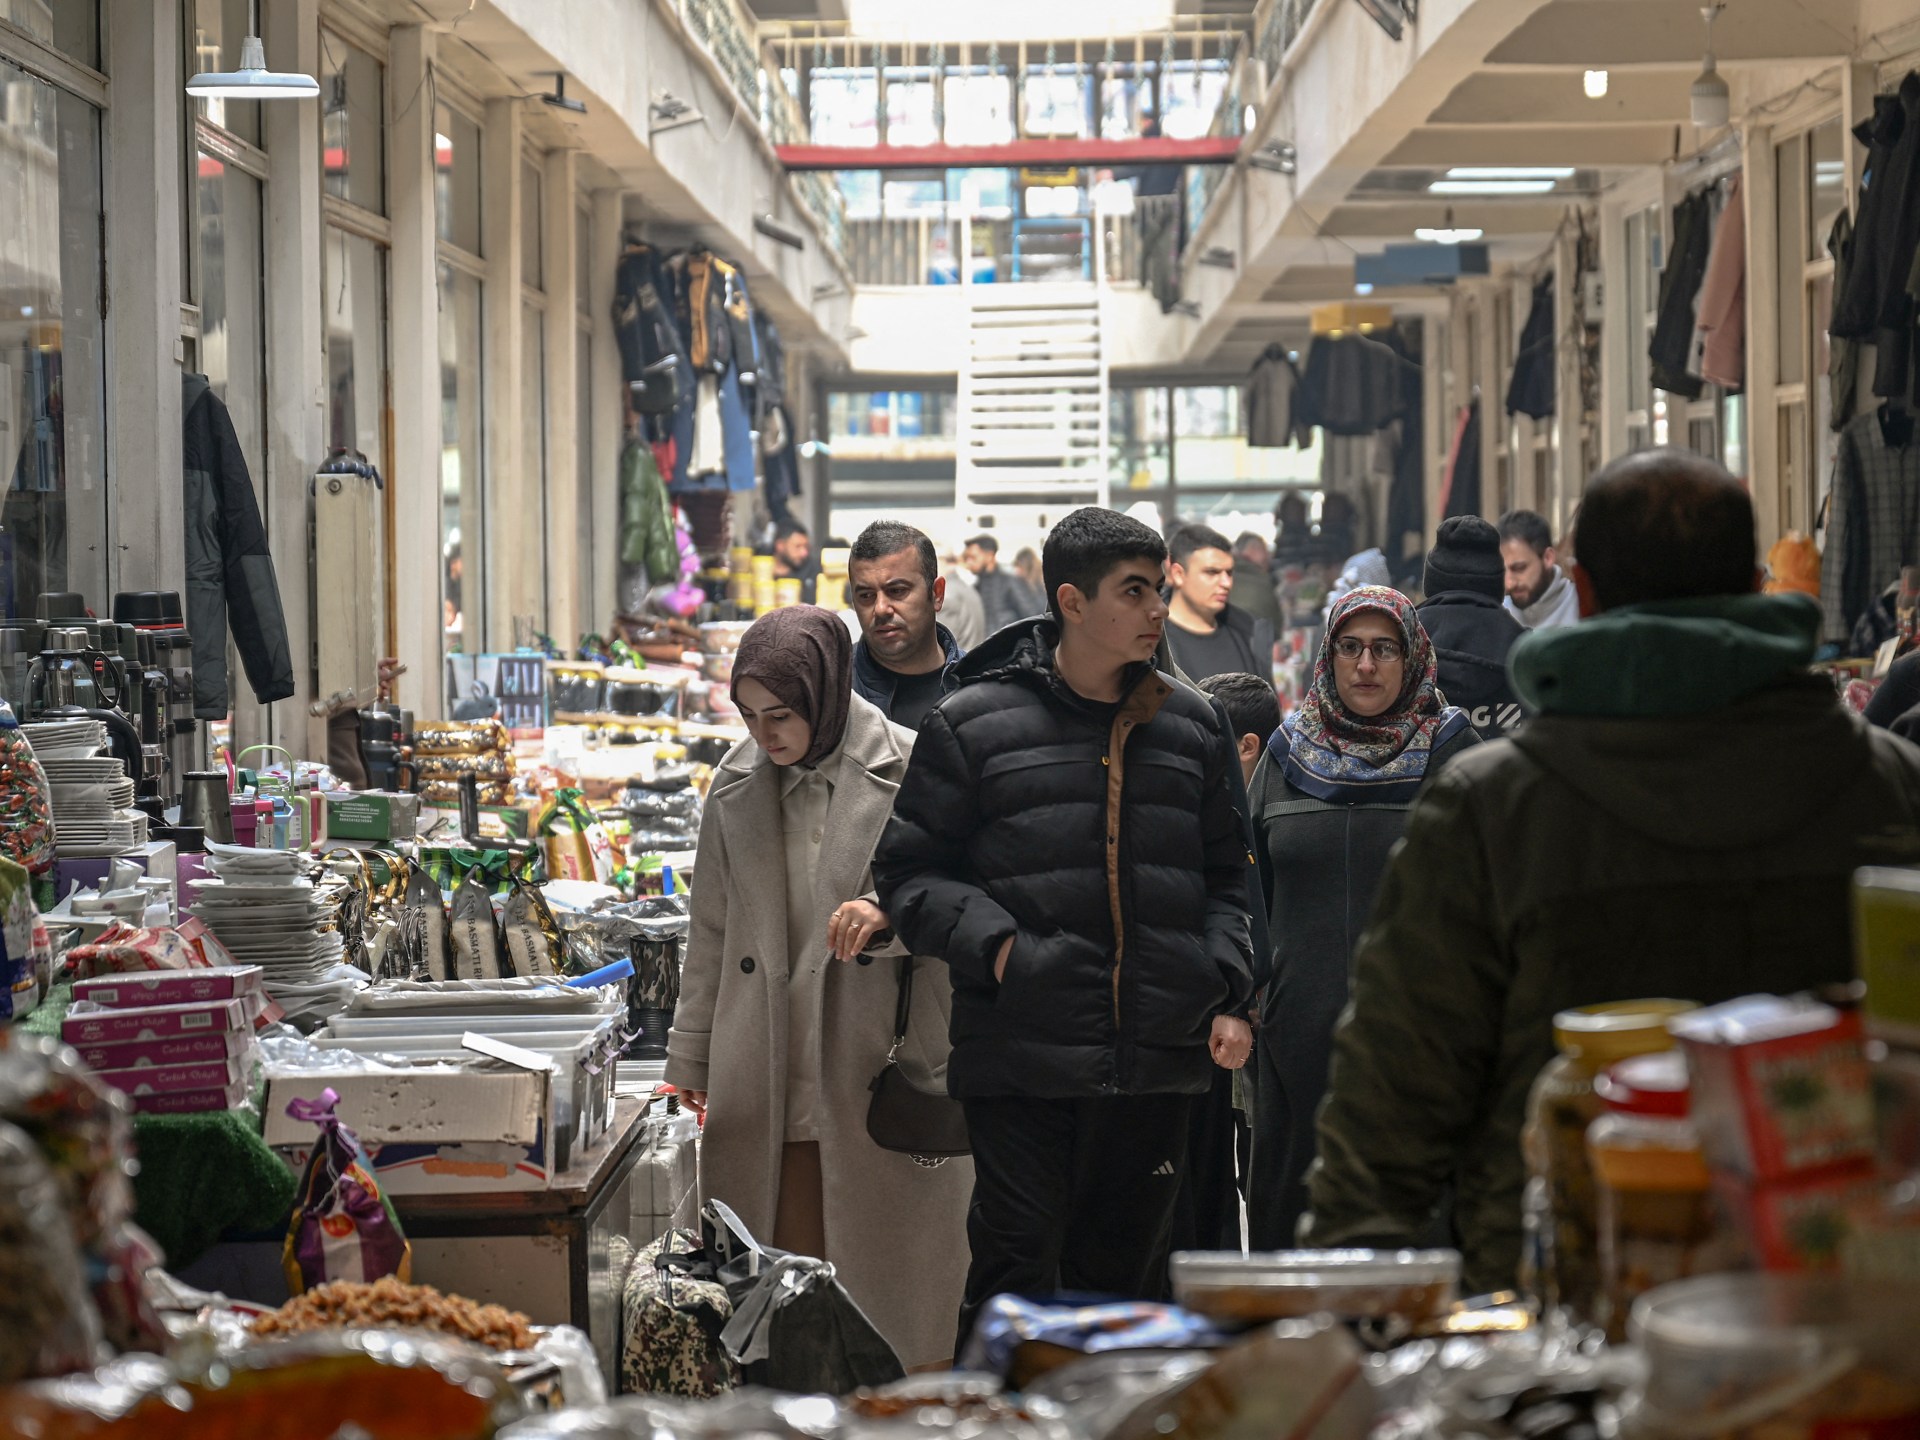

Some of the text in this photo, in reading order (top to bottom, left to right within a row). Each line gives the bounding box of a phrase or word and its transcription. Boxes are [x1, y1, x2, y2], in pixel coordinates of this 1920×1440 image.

[467, 917, 481, 965] BASMATI
[521, 928, 540, 973] BASMATI
[158, 1069, 218, 1082] Turkish Delight
